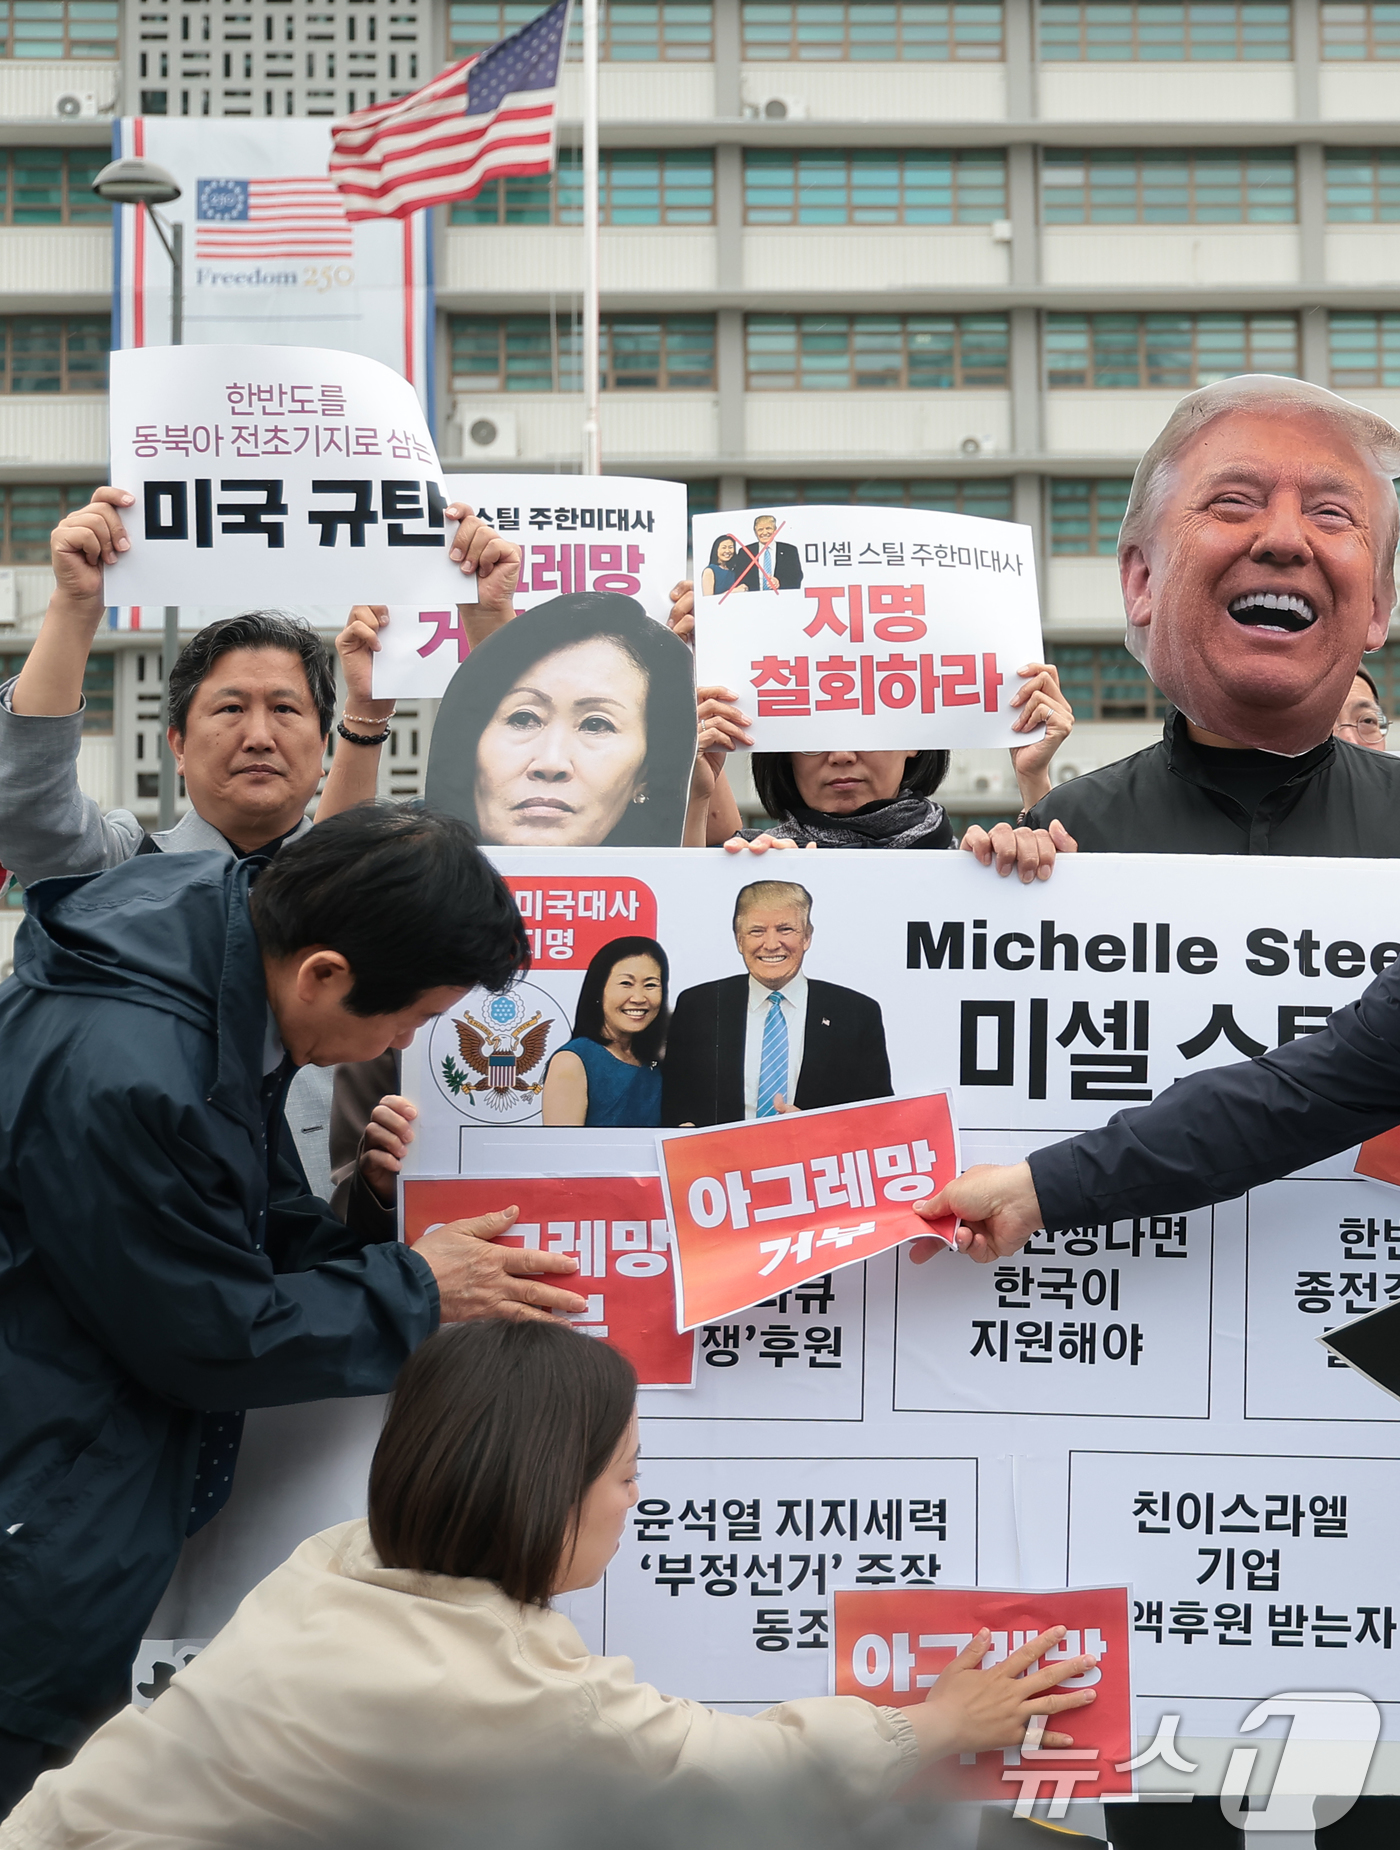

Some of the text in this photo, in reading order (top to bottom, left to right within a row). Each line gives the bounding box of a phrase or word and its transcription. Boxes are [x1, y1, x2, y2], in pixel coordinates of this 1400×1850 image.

[196, 265, 354, 293] Freedom 250
[225, 382, 347, 417] 한반도를
[132, 424, 433, 465] 동북아 전초기지로 삼는
[143, 478, 447, 548] 미국 규탄
[528, 507, 654, 533] 주한미대사
[804, 541, 1023, 576] 미셸 스틸 주한미대사
[802, 584, 928, 643] 지명
[750, 653, 1004, 717] 철회하라
[906, 919, 1219, 974] Michelle
[959, 998, 1333, 1101] 미셸 스
[688, 1139, 938, 1230] 아그레망
[757, 1221, 877, 1277] 거부
[993, 1265, 1120, 1312] 한국이
[969, 1319, 1144, 1367] 지원해야
[633, 1498, 947, 1542] 윤석열 지지세력
[1132, 1490, 1349, 1538] 친이스라엘
[1196, 1547, 1280, 1592] 기업
[1268, 1604, 1397, 1649] 받는자
